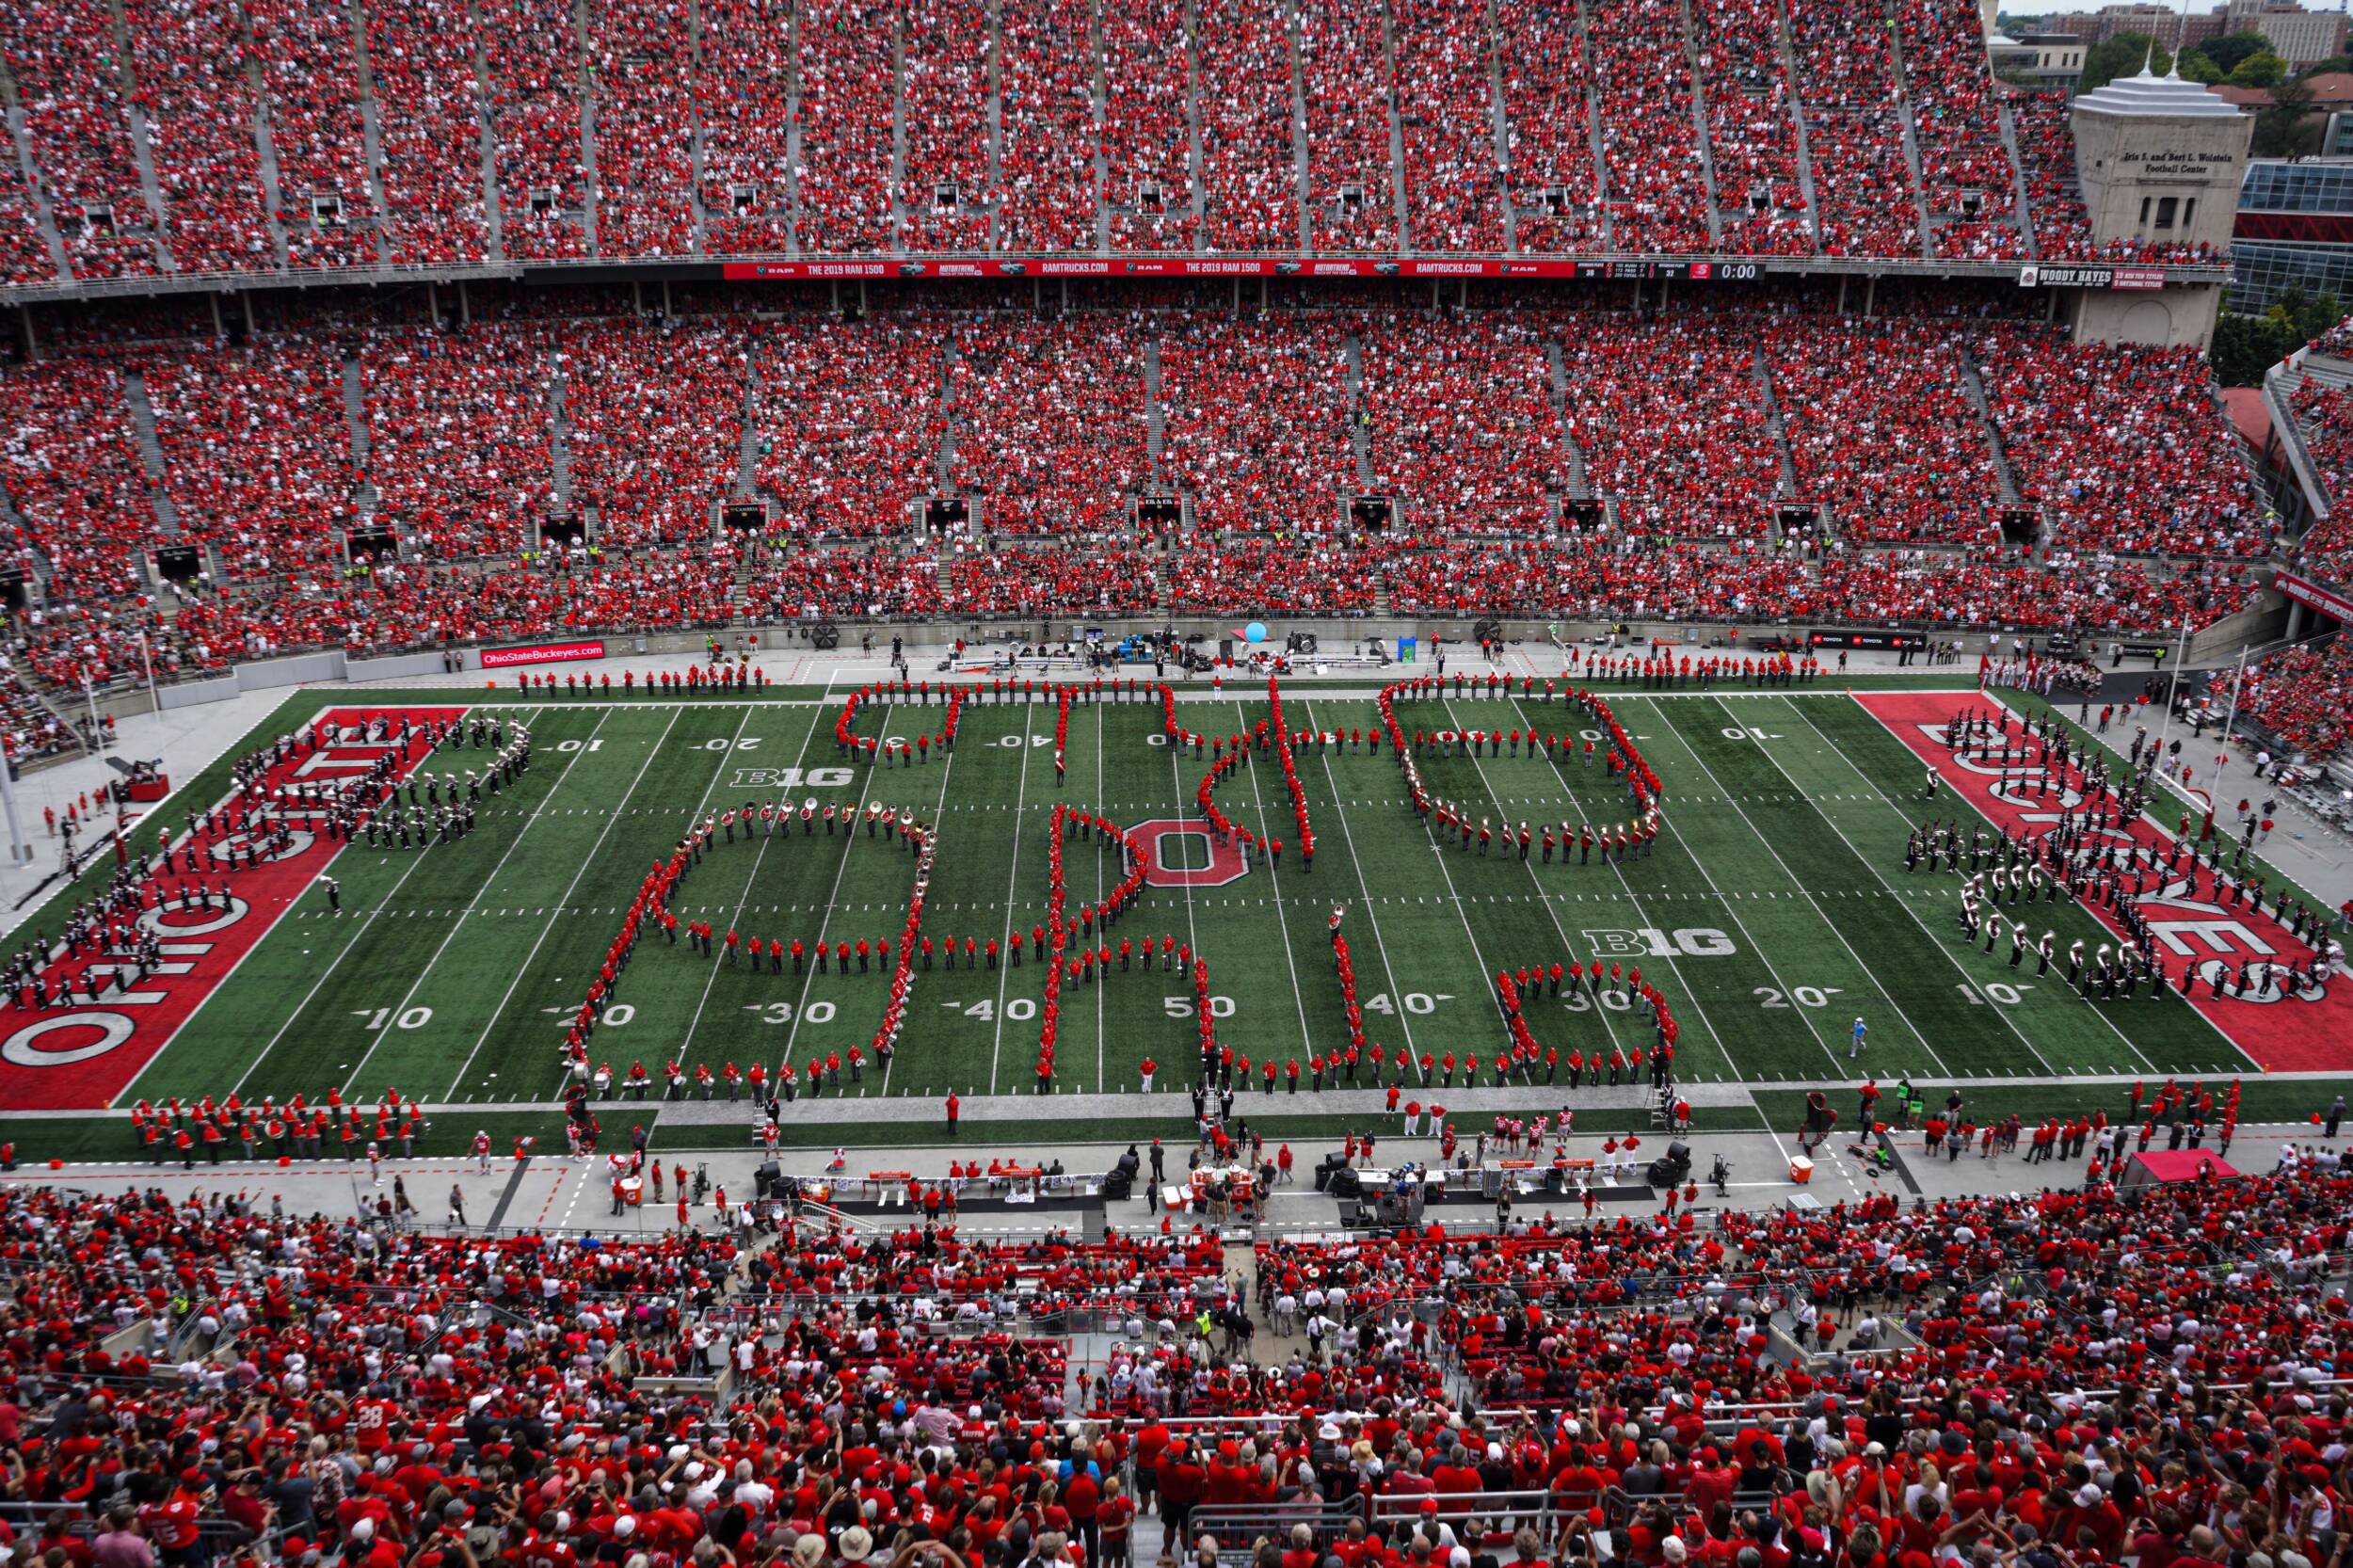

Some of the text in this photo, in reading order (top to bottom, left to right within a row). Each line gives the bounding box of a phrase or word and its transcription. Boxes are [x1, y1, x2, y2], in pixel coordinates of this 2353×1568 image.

[2124, 152, 2138, 161] Iris
[2151, 152, 2166, 162] and
[2168, 153, 2185, 162] Bert
[2187, 153, 2196, 162] L.
[2199, 153, 2233, 162] Wolstein
[2146, 164, 2208, 173] Football Center
[808, 264, 885, 275] THE 2019 RAM 1500
[1042, 264, 1108, 273] RAMTRUCKS.COM
[1186, 263, 1260, 272] THE 2019 RAM 1500
[1417, 264, 1482, 273] RAMTRUCKS.COM
[1721, 264, 1755, 279] 0:00
[2040, 269, 2112, 282] WOODY HAYES
[2288, 582, 2312, 600] HOME
[484, 647, 602, 664] OhioStateBuckeyes.com
[555, 739, 603, 751] 10
[706, 738, 761, 750] 20
[1000, 735, 1053, 747] 40
[1, 894, 250, 1067] OHIO
[1561, 988, 1633, 1012] 30
[1753, 986, 1829, 1008] 20
[1956, 983, 2023, 1005] 10
[964, 998, 1036, 1021] 40
[1164, 996, 1236, 1017] 50
[1364, 992, 1435, 1015] 40
[365, 1007, 433, 1030] 10
[763, 1000, 837, 1024] 30
[627, 1191, 636, 1200] G
[1233, 1187, 1244, 1196] G
[359, 1405, 383, 1429] 28
